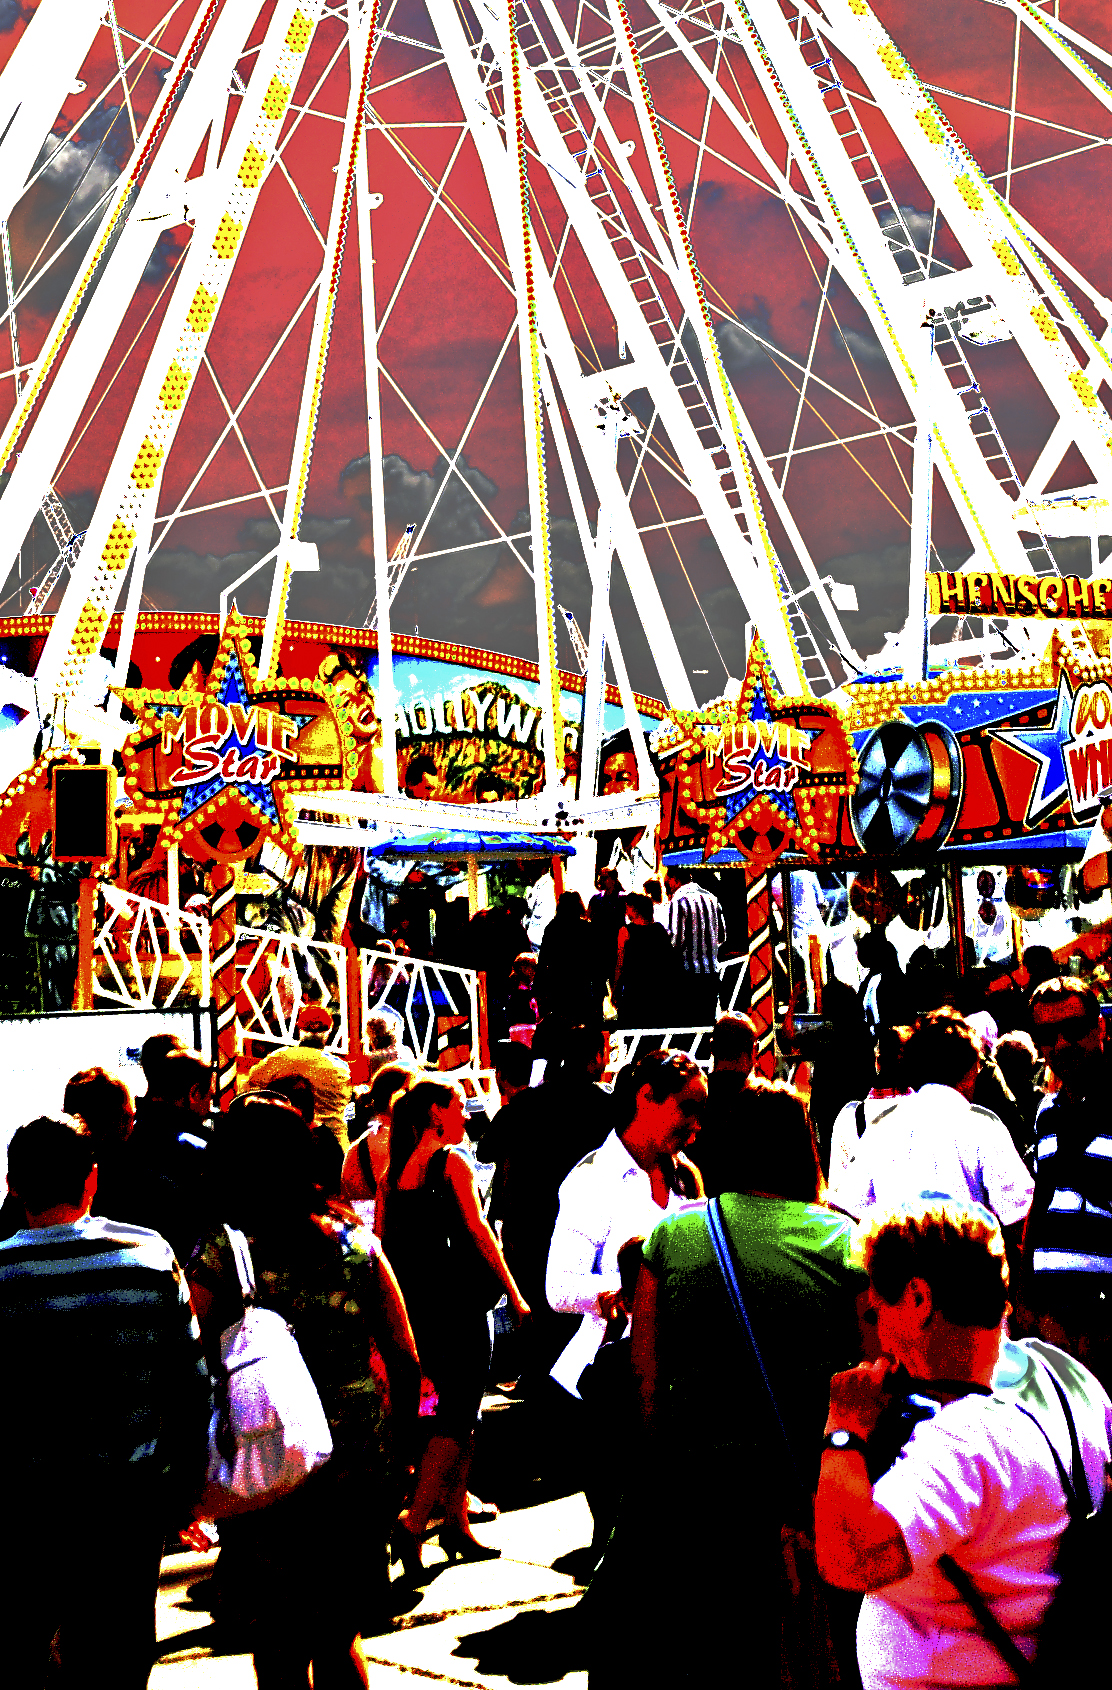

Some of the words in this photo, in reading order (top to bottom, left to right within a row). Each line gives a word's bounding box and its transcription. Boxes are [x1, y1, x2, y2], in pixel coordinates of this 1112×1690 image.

[161, 702, 299, 763] MOVIE
[704, 718, 811, 772] MOVIE
[169, 733, 281, 787] Star
[713, 748, 799, 797] Star
